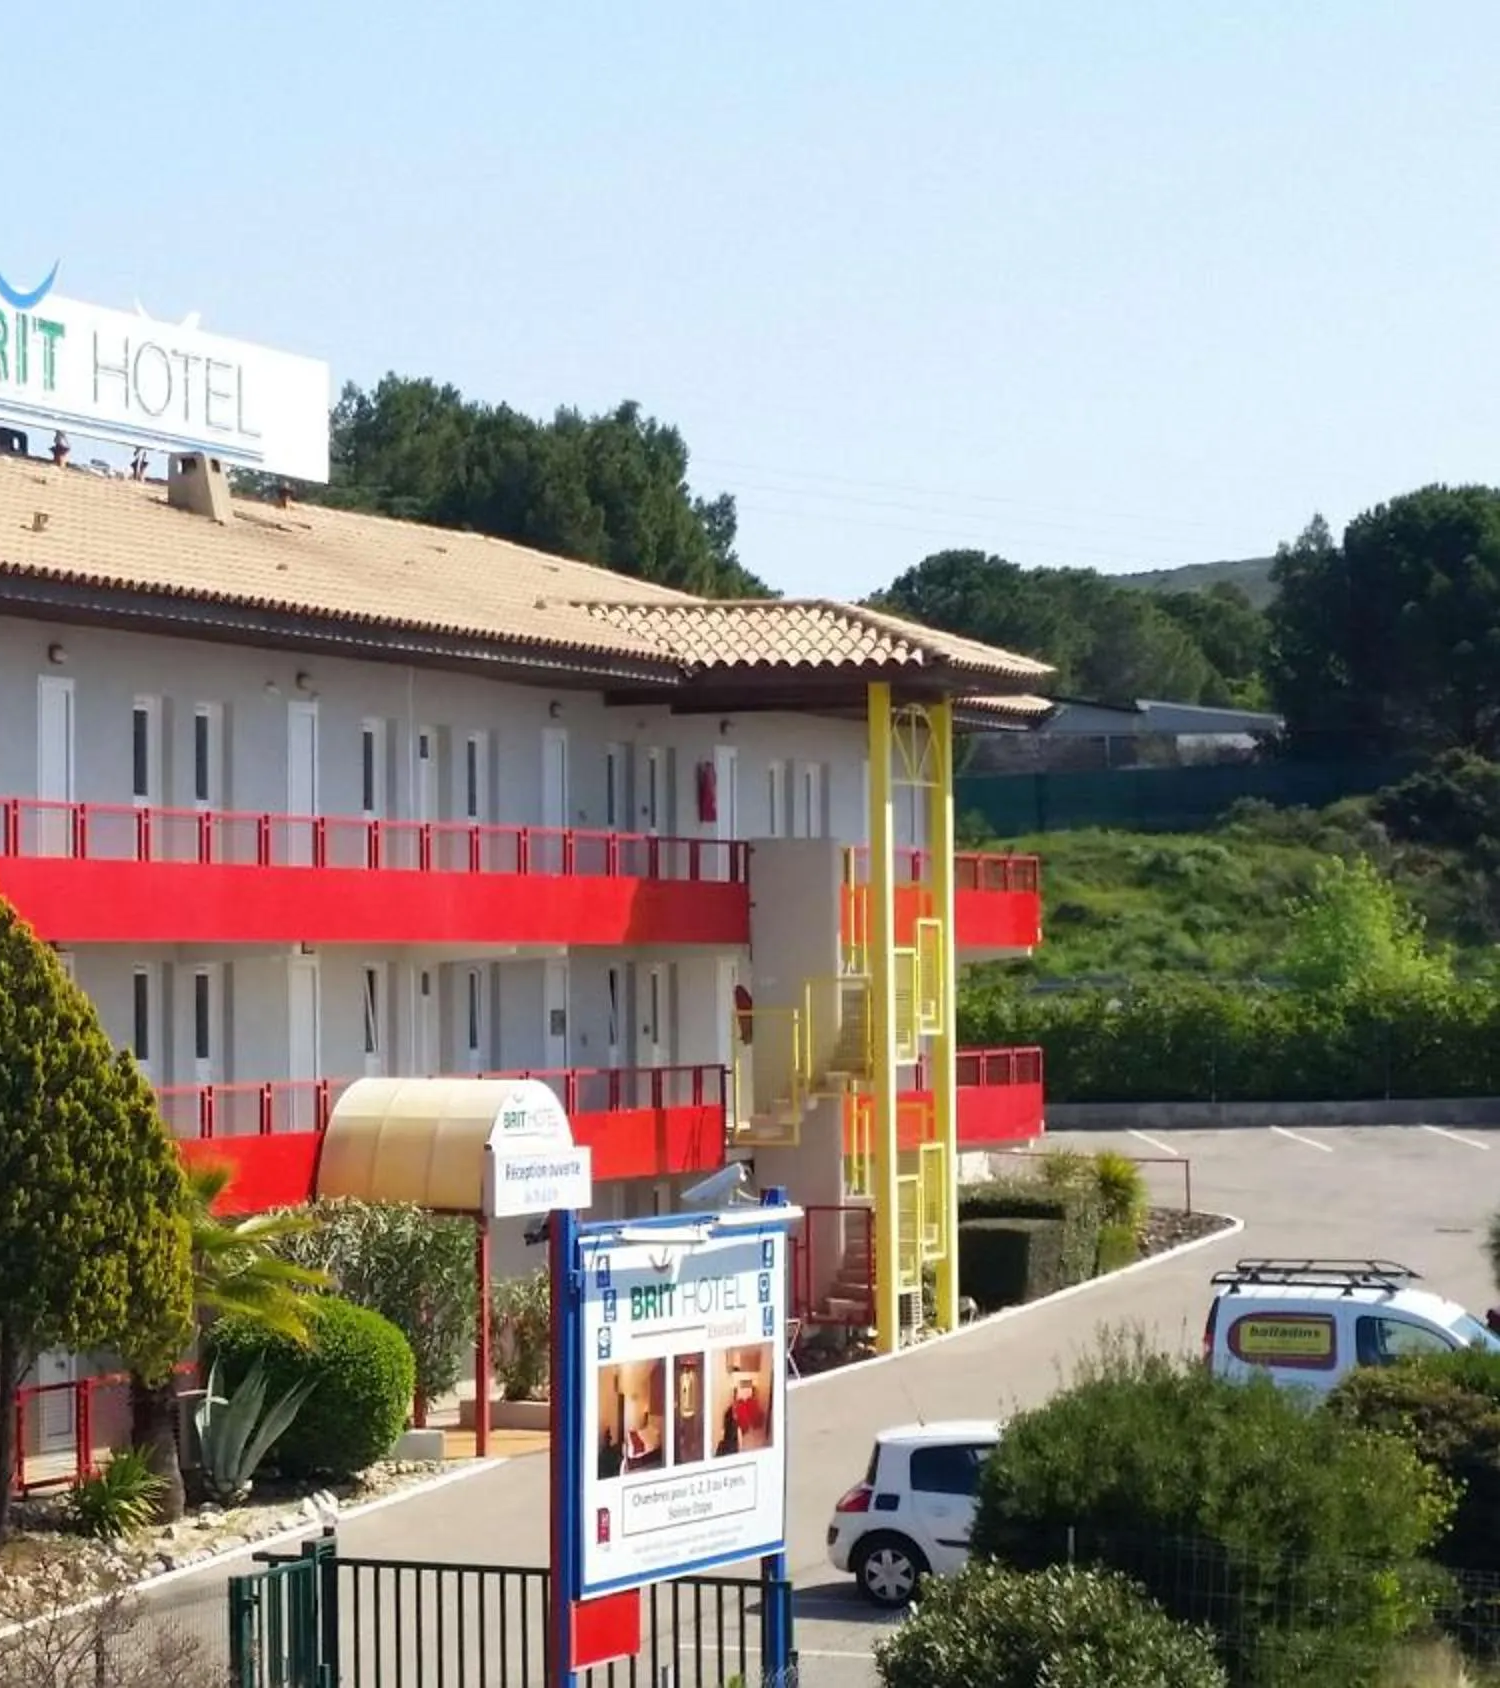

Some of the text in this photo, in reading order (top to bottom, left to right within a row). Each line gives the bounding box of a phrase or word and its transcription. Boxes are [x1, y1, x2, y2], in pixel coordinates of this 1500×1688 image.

[92, 329, 262, 438] HOTEL
[503, 1110, 527, 1129] BRIT
[630, 1276, 748, 1321] BRIT HOTEL
